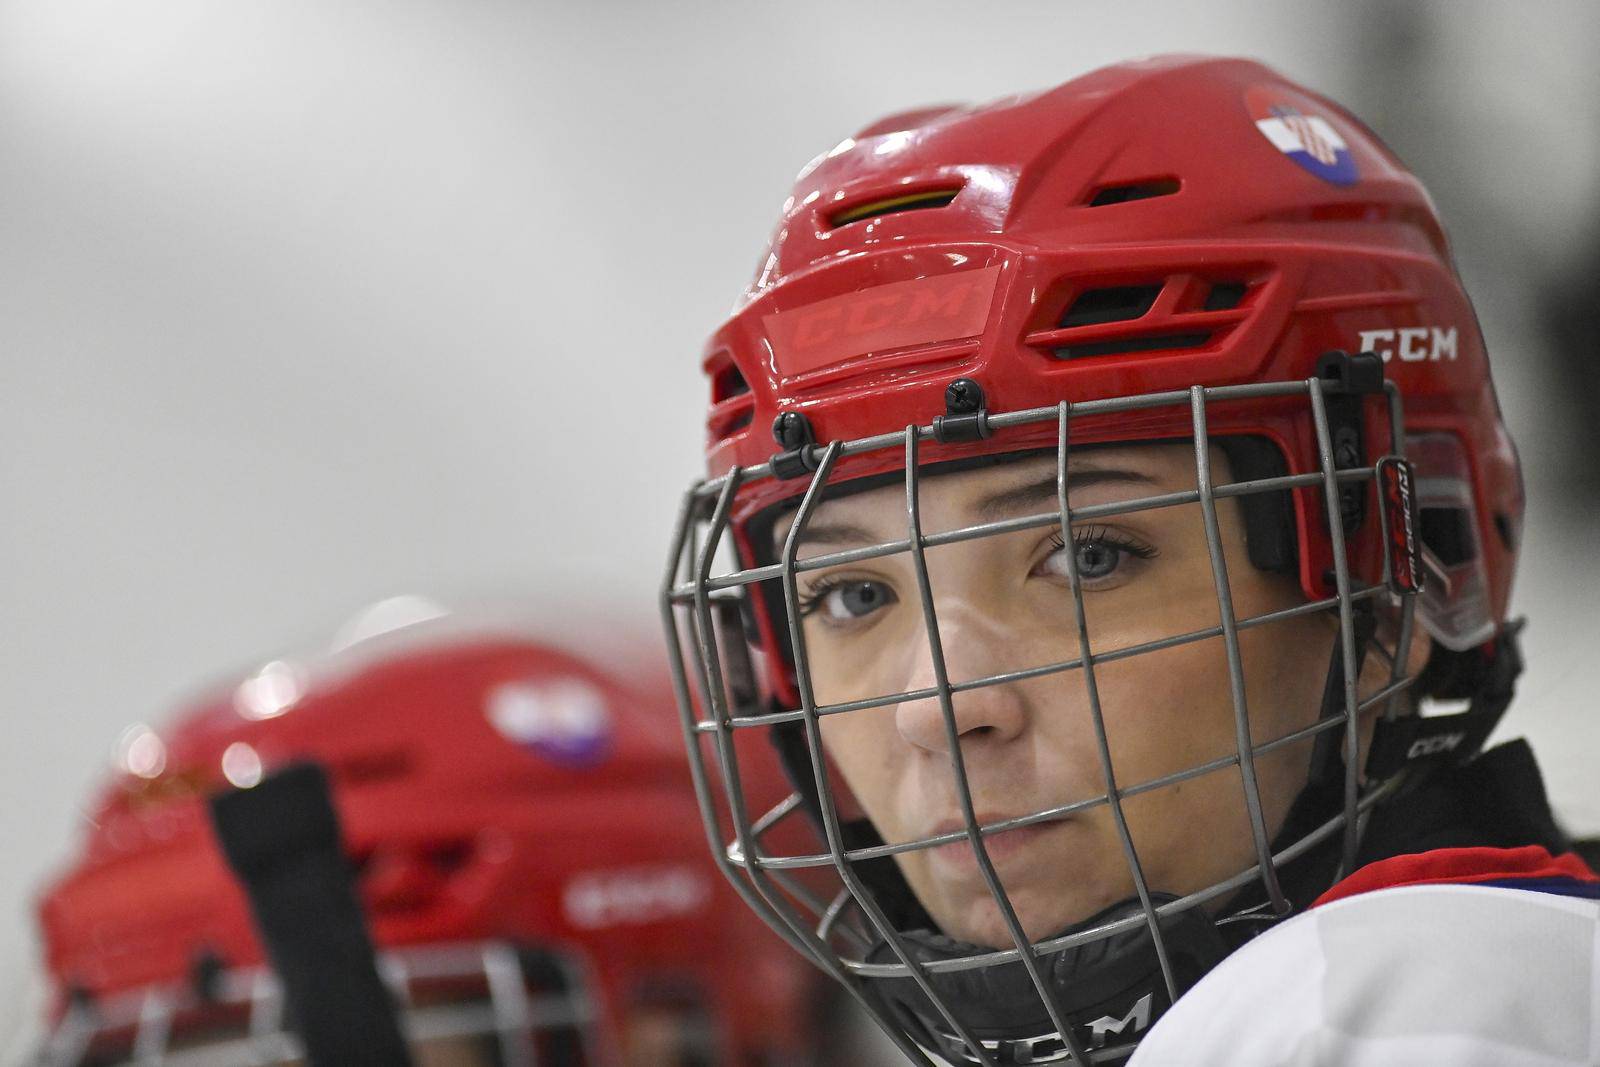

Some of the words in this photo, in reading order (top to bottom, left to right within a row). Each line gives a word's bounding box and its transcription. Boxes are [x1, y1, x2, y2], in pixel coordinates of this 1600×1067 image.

[793, 283, 972, 349] CCM
[1358, 326, 1458, 363] CCM
[1407, 732, 1463, 759] CCM
